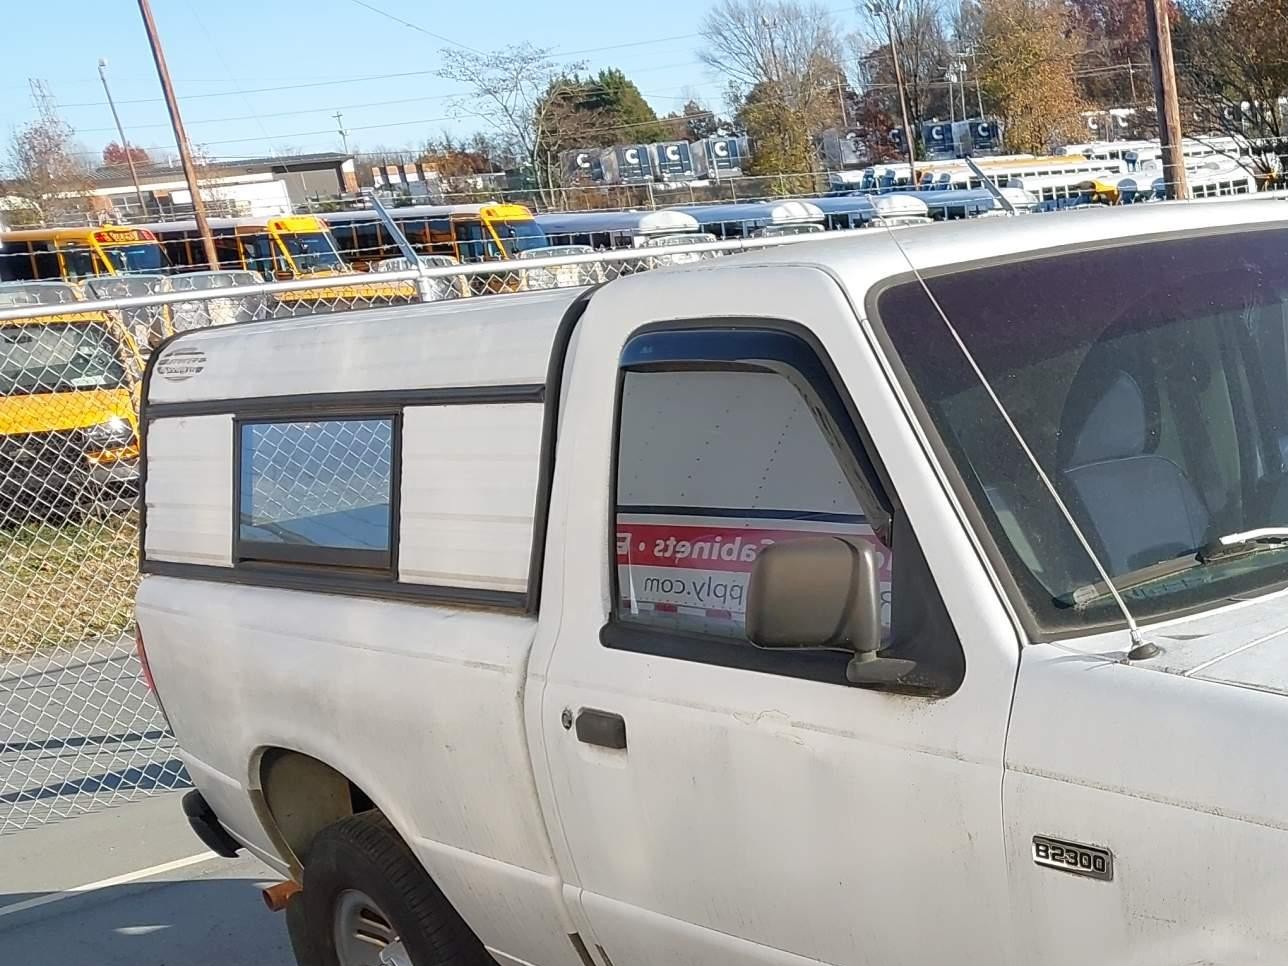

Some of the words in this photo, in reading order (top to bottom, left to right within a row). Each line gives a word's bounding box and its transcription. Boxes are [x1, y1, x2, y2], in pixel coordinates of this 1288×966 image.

[932, 126, 944, 140] C
[978, 123, 989, 137] C
[666, 145, 680, 160] C
[715, 141, 728, 156] C
[576, 153, 590, 168] C
[626, 149, 639, 164] C
[1035, 842, 1106, 873] B2300
